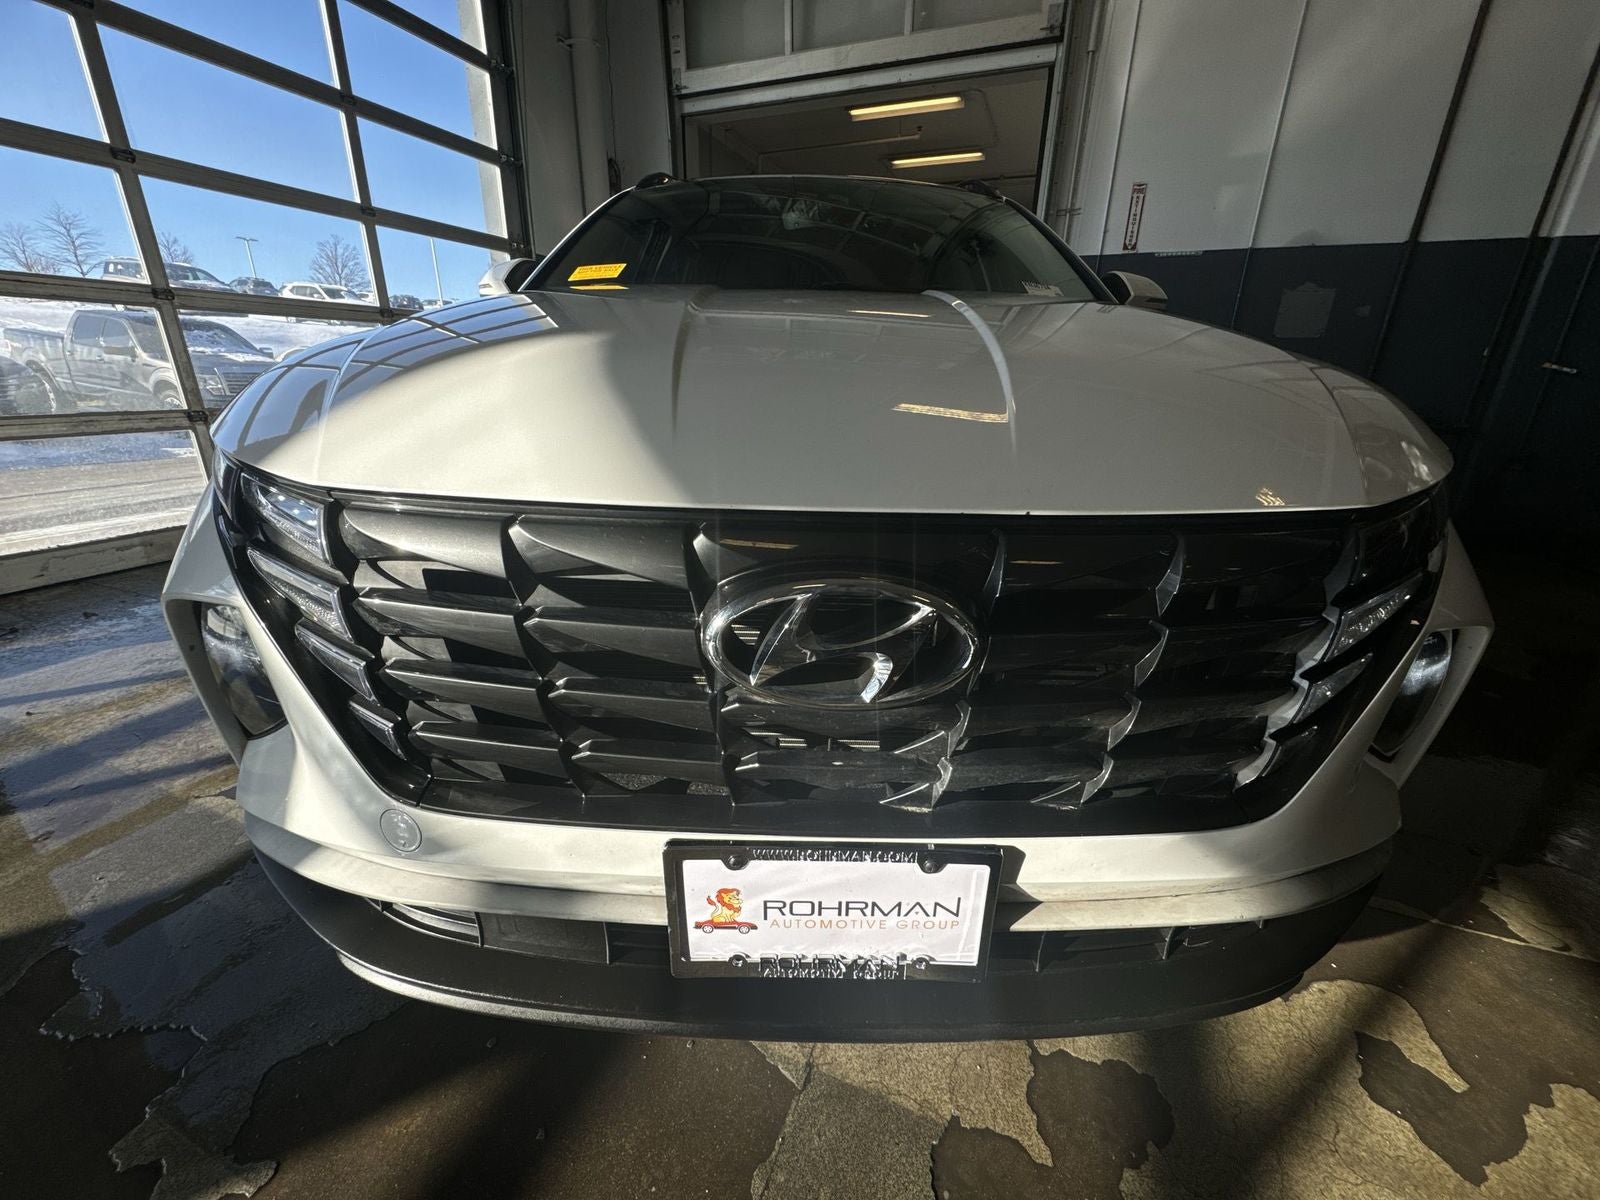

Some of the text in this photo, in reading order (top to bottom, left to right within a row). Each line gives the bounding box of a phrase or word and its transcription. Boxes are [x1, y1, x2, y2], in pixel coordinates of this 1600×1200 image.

[763, 897, 962, 920] ROHRMAN
[770, 919, 960, 930] AUTOMOTIVE GROUP
